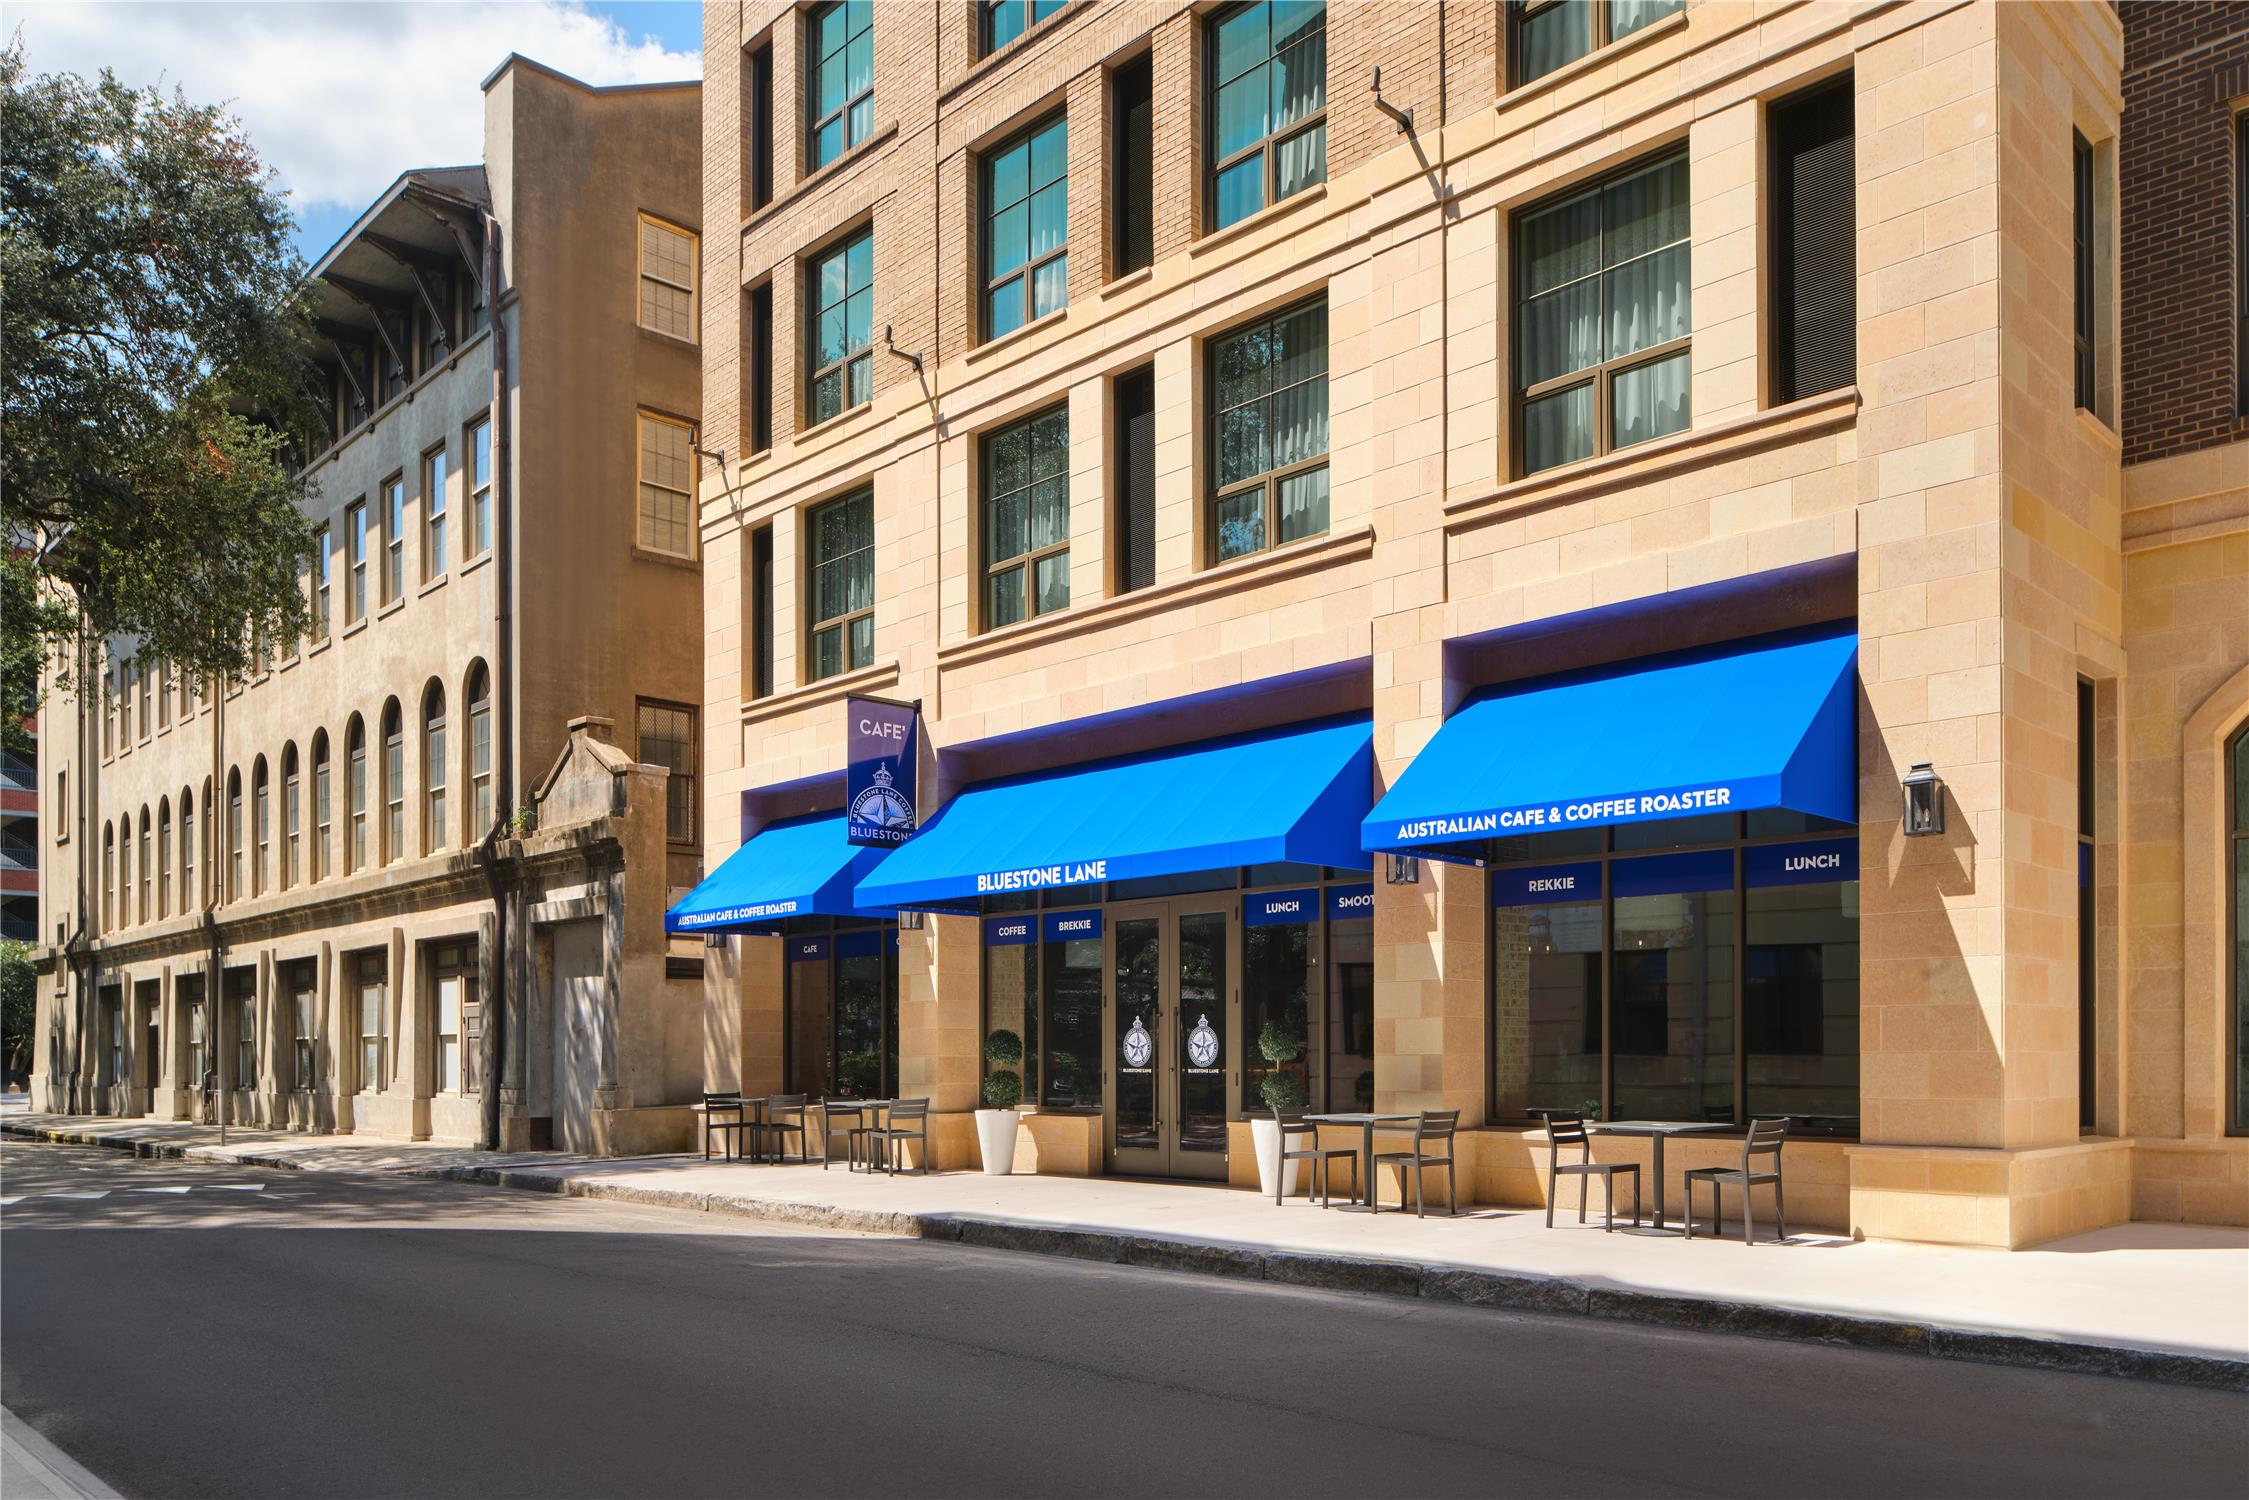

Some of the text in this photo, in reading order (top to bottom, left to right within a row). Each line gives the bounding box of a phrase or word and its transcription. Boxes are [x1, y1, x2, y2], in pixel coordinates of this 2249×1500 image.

[852, 788, 914, 825] BLUESTONE LANE COFFEE
[1397, 788, 1730, 840] AUSTRALIAN CAFE & COFFEE ROASTER
[850, 826, 912, 841] BLUESTON
[1785, 854, 1840, 871] LUNCH
[977, 860, 1106, 892] BLUESTONE LANE
[1528, 877, 1575, 892] REKKIE
[678, 901, 797, 926] AUSTRALIAN CAFE & COFFEE ROASTER
[1266, 901, 1299, 914] LUNCH
[998, 925, 1027, 937] COFFEE
[1058, 920, 1092, 931] BREKKIE
[803, 944, 818, 954] CAFE
